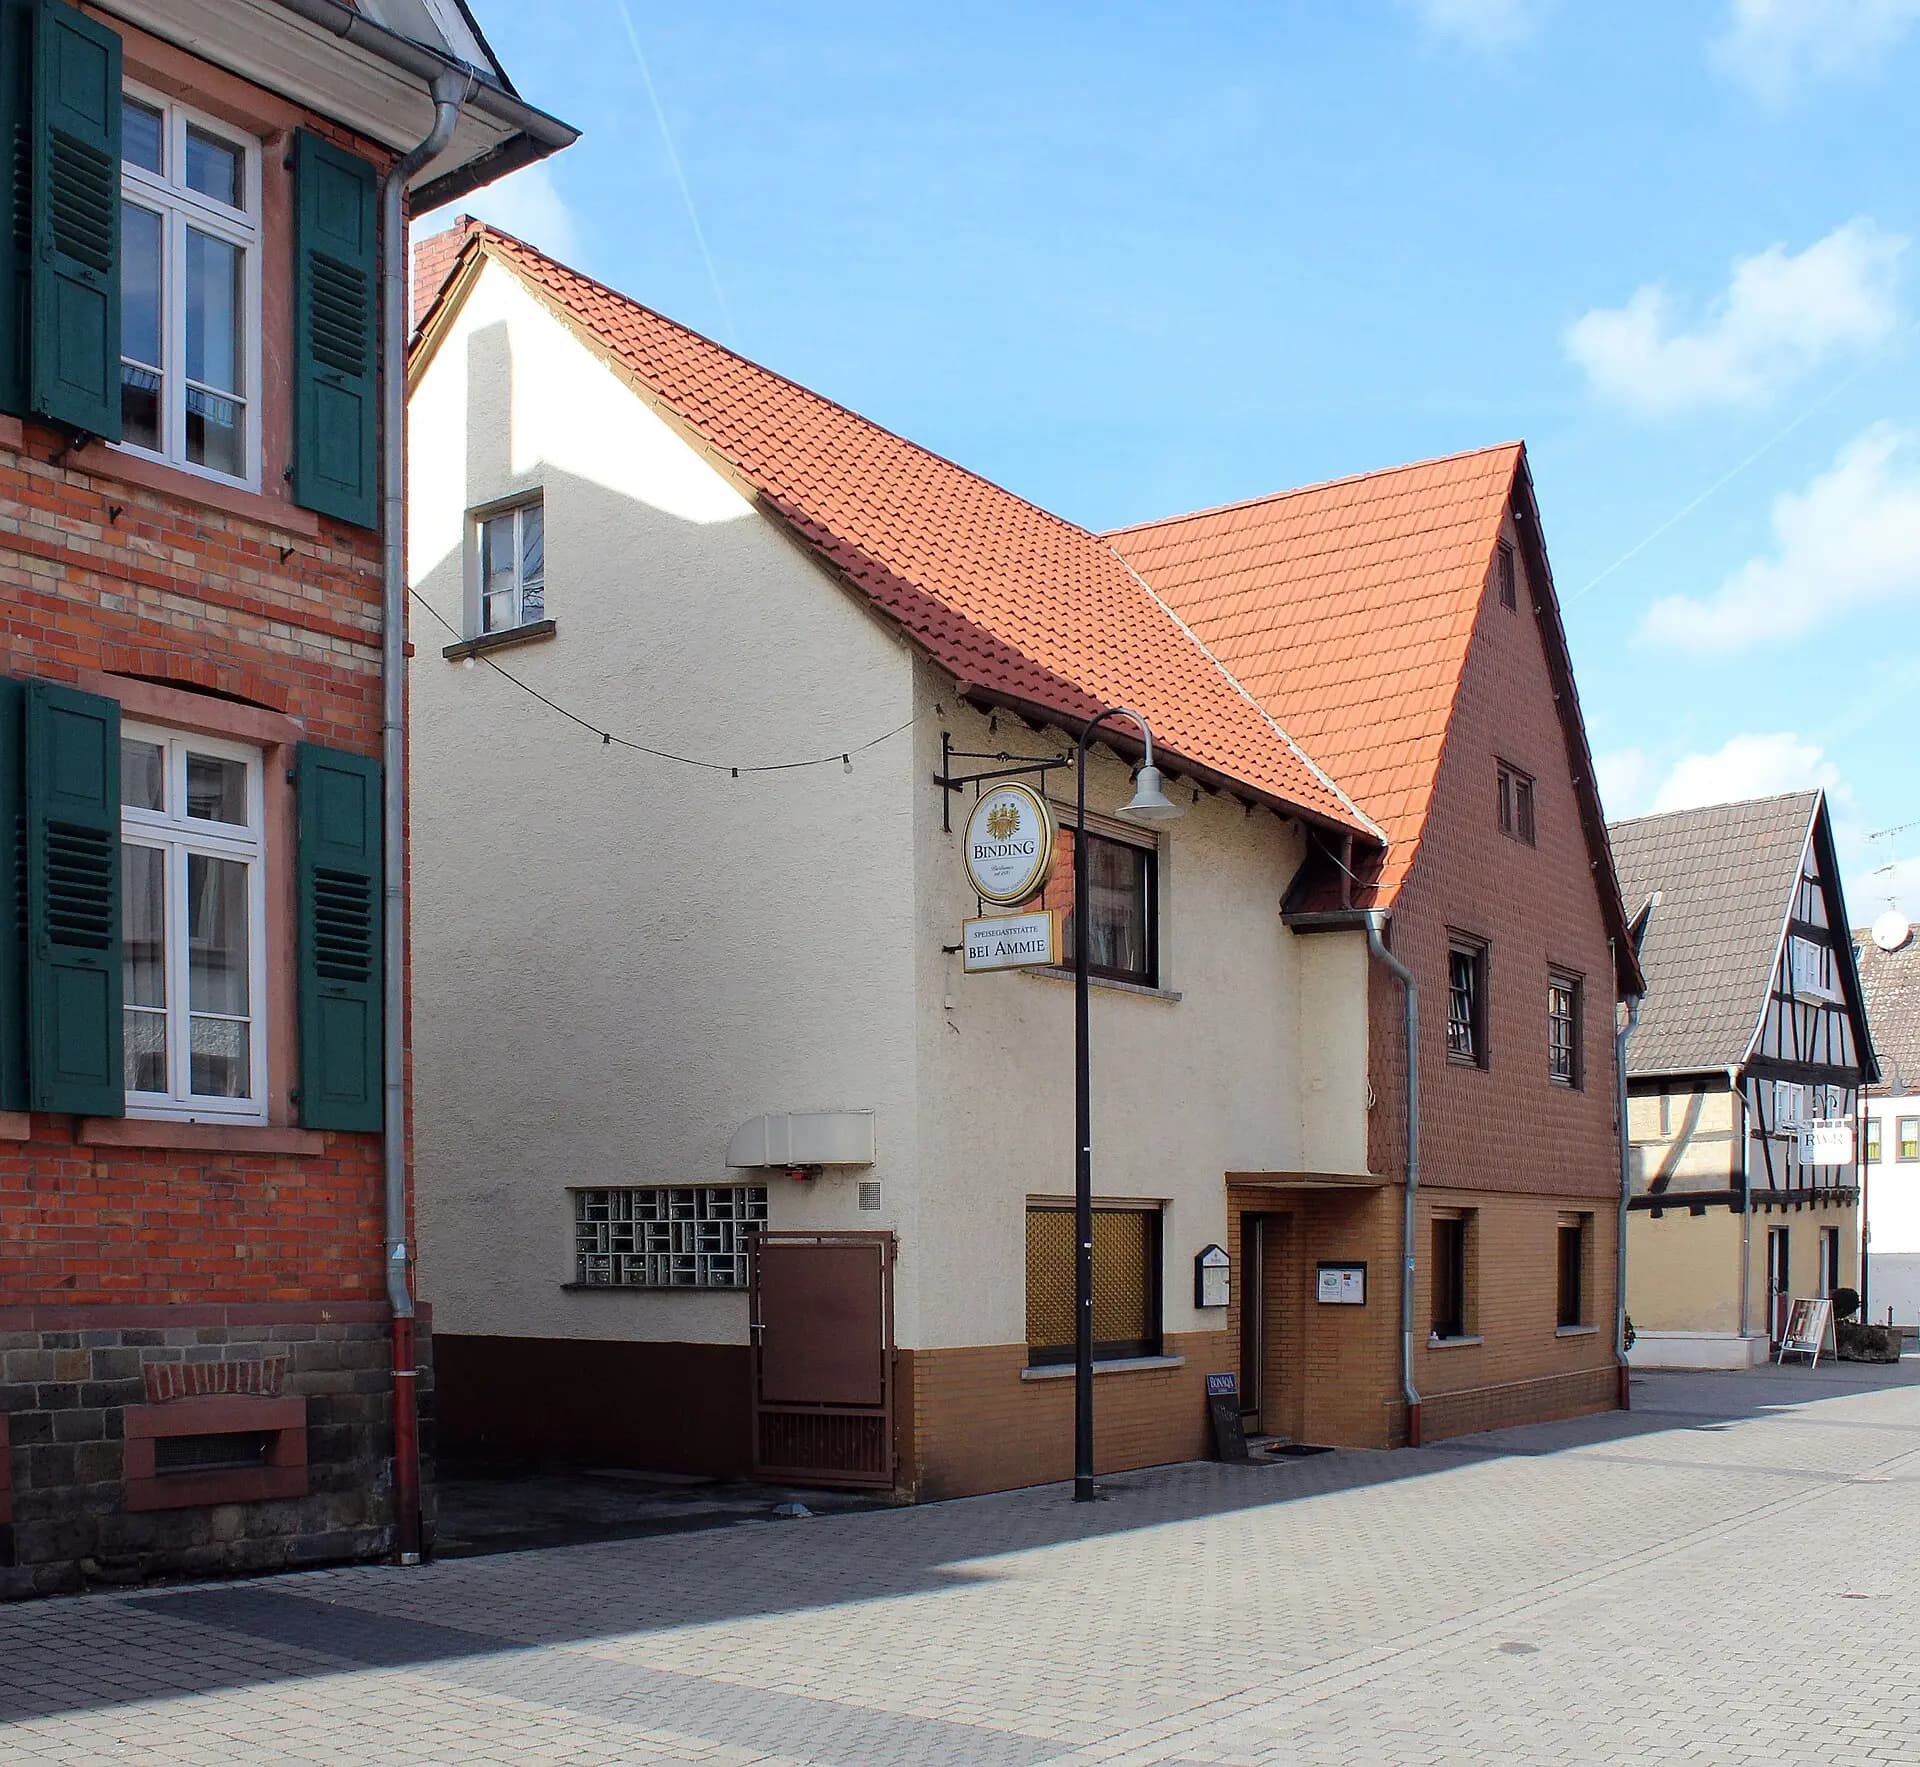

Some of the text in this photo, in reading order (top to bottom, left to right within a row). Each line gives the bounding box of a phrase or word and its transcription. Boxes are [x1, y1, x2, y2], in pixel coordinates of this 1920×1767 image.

[974, 840, 1035, 859] BINDING
[969, 940, 1046, 959] BEI AMMIE
